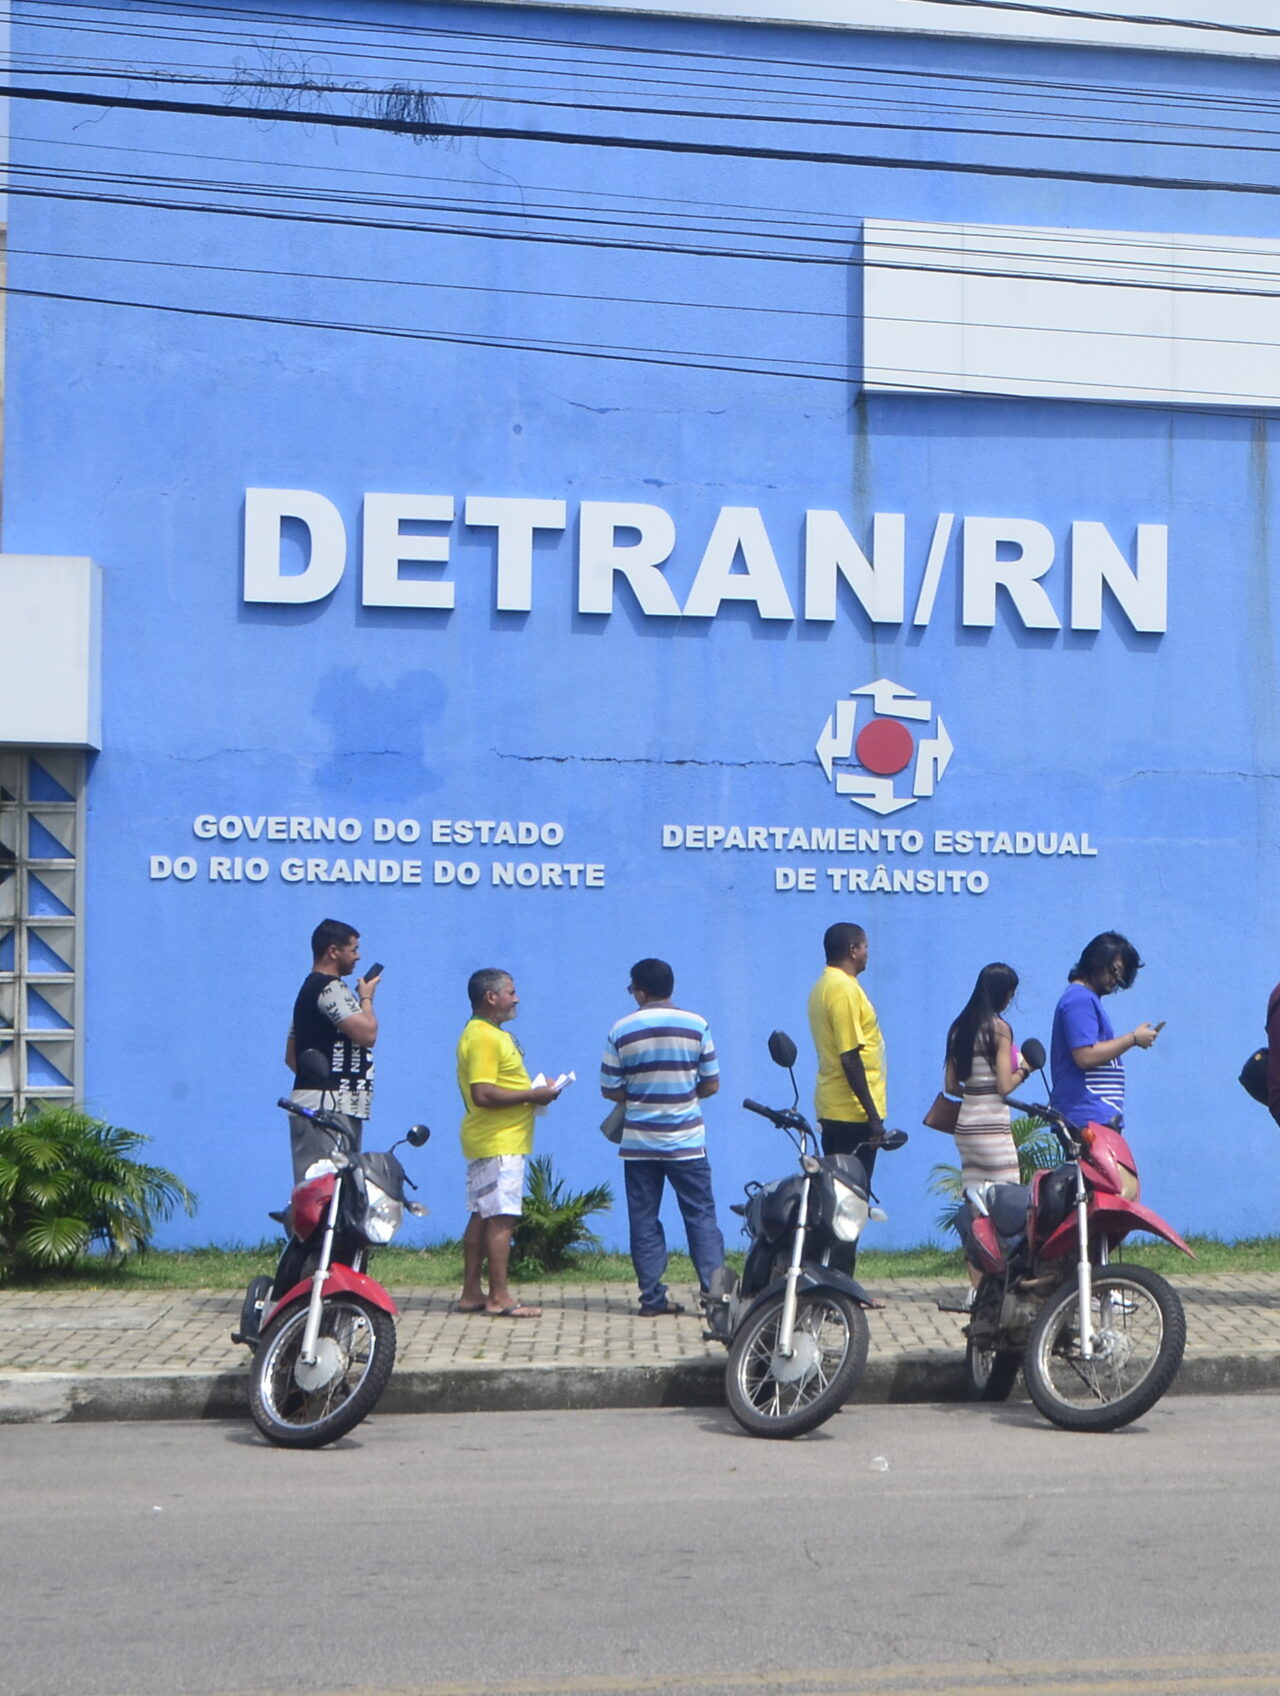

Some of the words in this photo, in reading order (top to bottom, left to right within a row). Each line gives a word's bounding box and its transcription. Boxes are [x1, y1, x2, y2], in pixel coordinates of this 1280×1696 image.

[244, 487, 1169, 632] DETRAN/RN
[194, 814, 362, 841] GOVERNO
[374, 818, 420, 842] DO
[432, 820, 564, 845] ESTADO
[663, 825, 923, 852] DEPARTAMENTO
[935, 830, 1098, 855] ESTADUAL
[151, 855, 197, 879] DO
[210, 856, 269, 880] RIO
[281, 858, 422, 883] GRANDE
[434, 860, 480, 884] DO
[492, 862, 605, 886] NORTE
[776, 867, 816, 890] DE
[827, 863, 989, 893] TRÂNSITO
